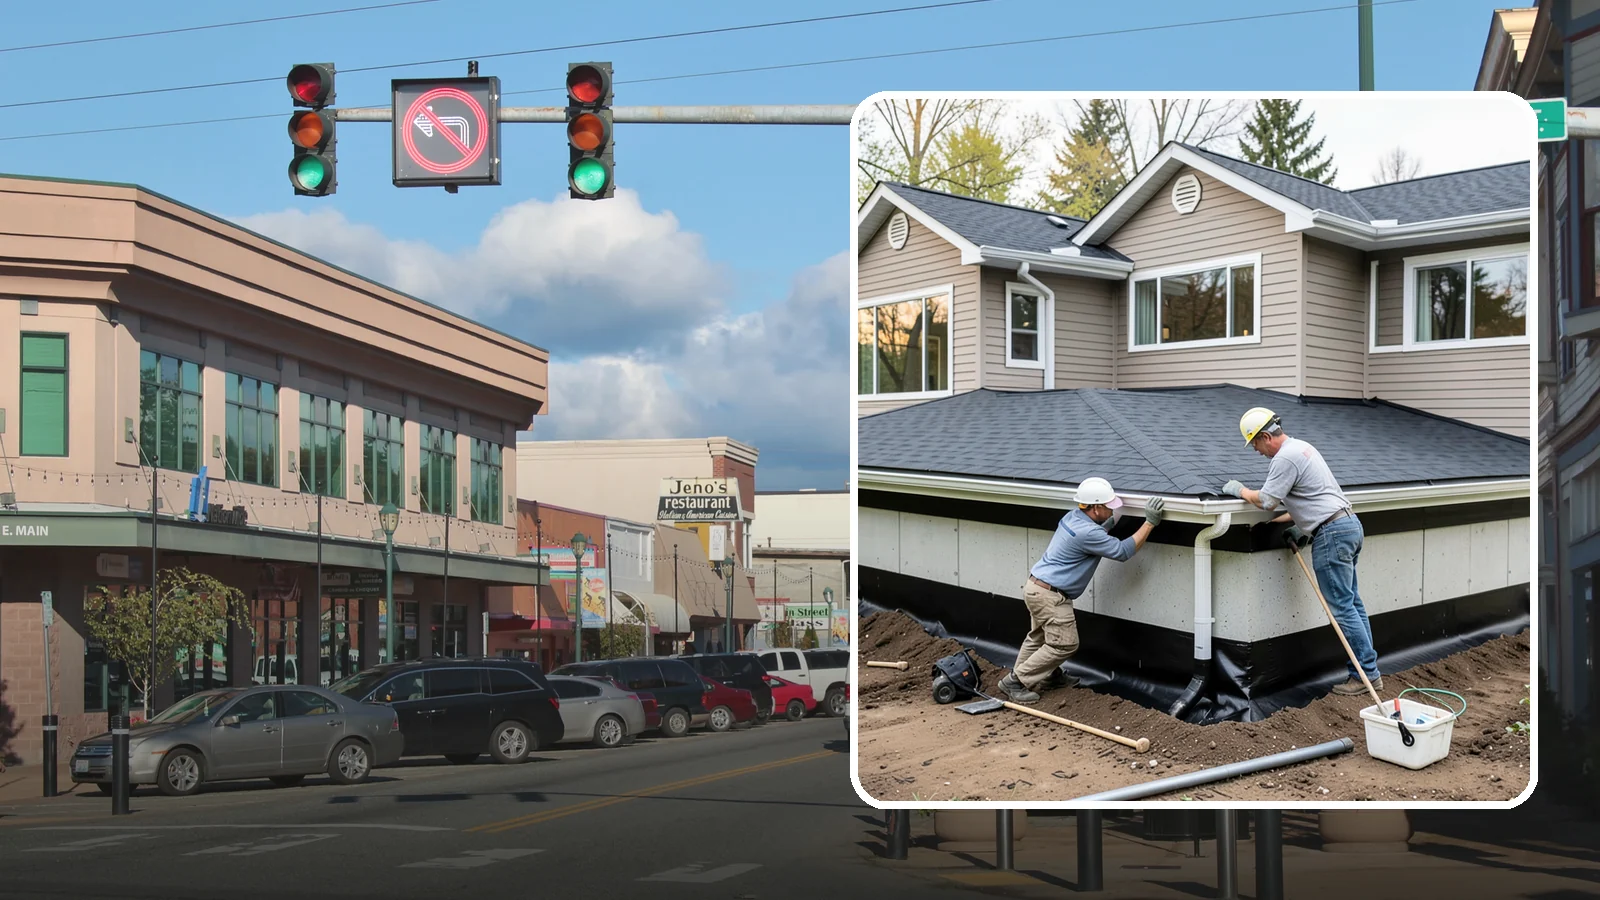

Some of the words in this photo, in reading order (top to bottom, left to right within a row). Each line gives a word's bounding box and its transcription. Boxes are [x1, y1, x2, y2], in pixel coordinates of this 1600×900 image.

[669, 479, 728, 495] Jeno's
[665, 496, 731, 509] restaurant
[658, 509, 681, 520] Italian
[686, 509, 715, 519] American
[714, 509, 738, 519] Cuisine
[2, 525, 13, 536] E.
[15, 525, 49, 536] MAIN
[797, 607, 828, 617] Street
[790, 619, 824, 627] lass
